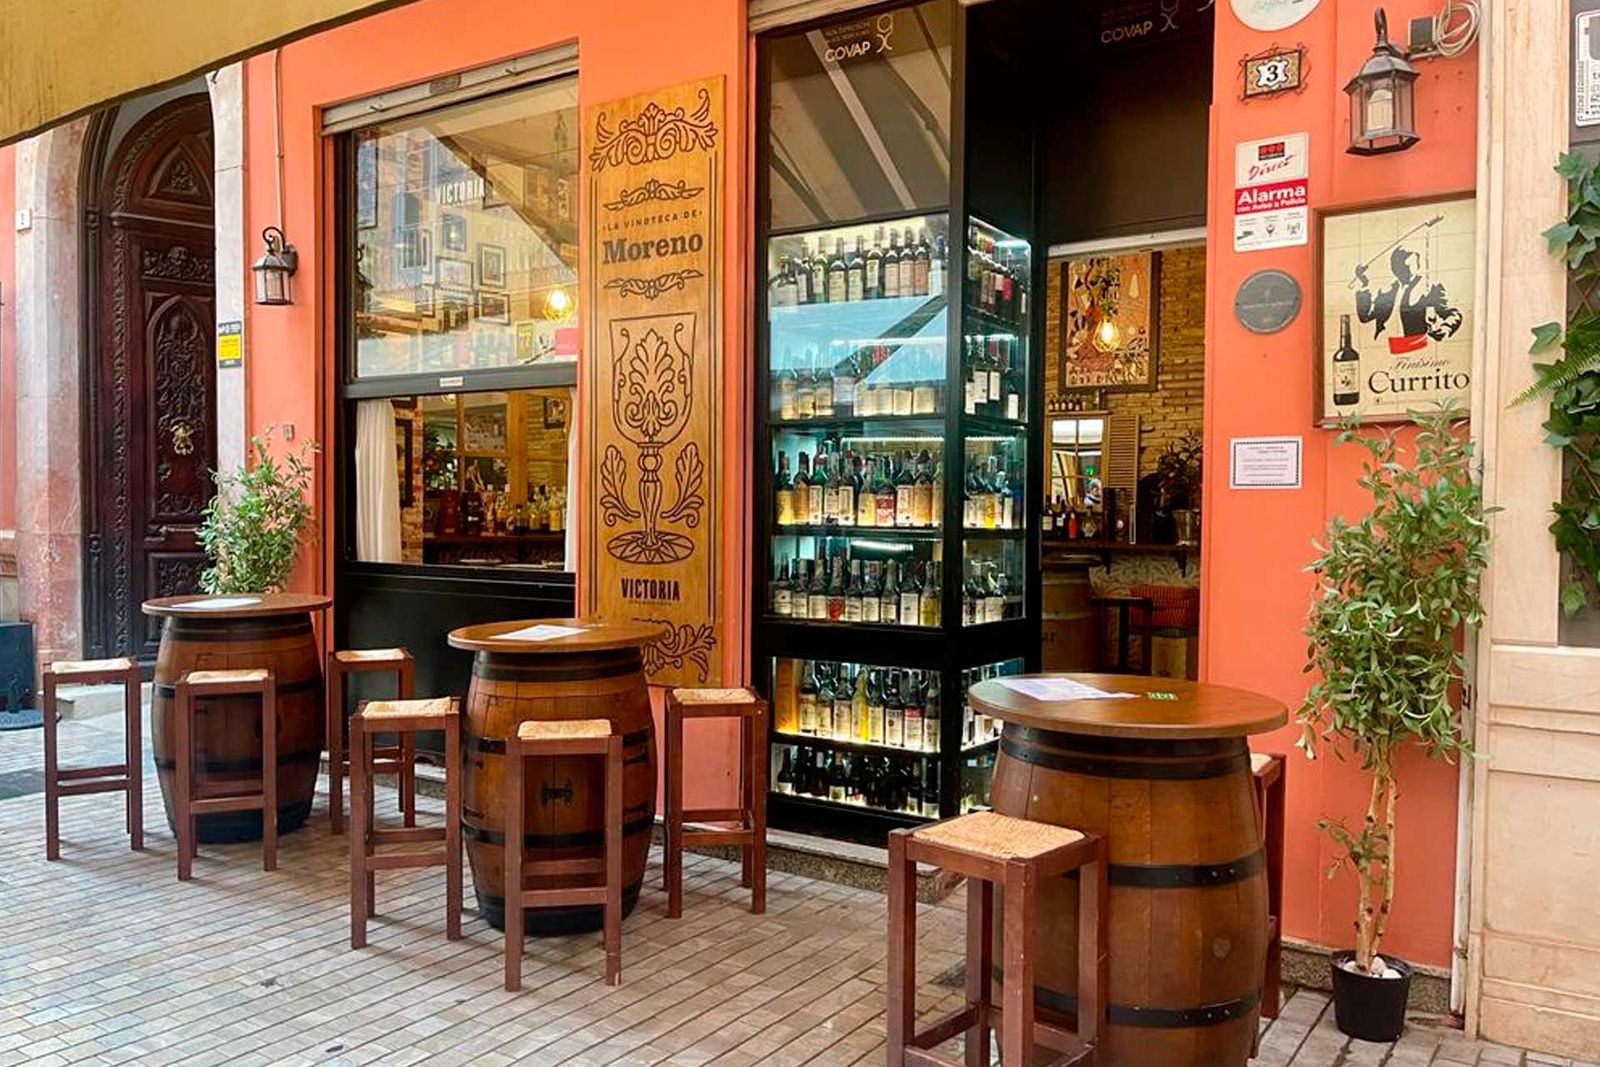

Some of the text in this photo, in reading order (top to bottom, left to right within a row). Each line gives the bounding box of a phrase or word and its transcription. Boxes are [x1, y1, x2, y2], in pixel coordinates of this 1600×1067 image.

[1101, 21, 1153, 43] COVAP
[825, 41, 871, 62] COVAP
[1266, 64, 1279, 82] 3
[437, 178, 485, 204] VICTORIA
[1237, 185, 1306, 205] Alarma
[607, 209, 698, 231] LA VINOTECA DE
[602, 233, 704, 265] Moreno
[1368, 367, 1471, 394] Currito
[621, 578, 681, 601] VICTORIA
